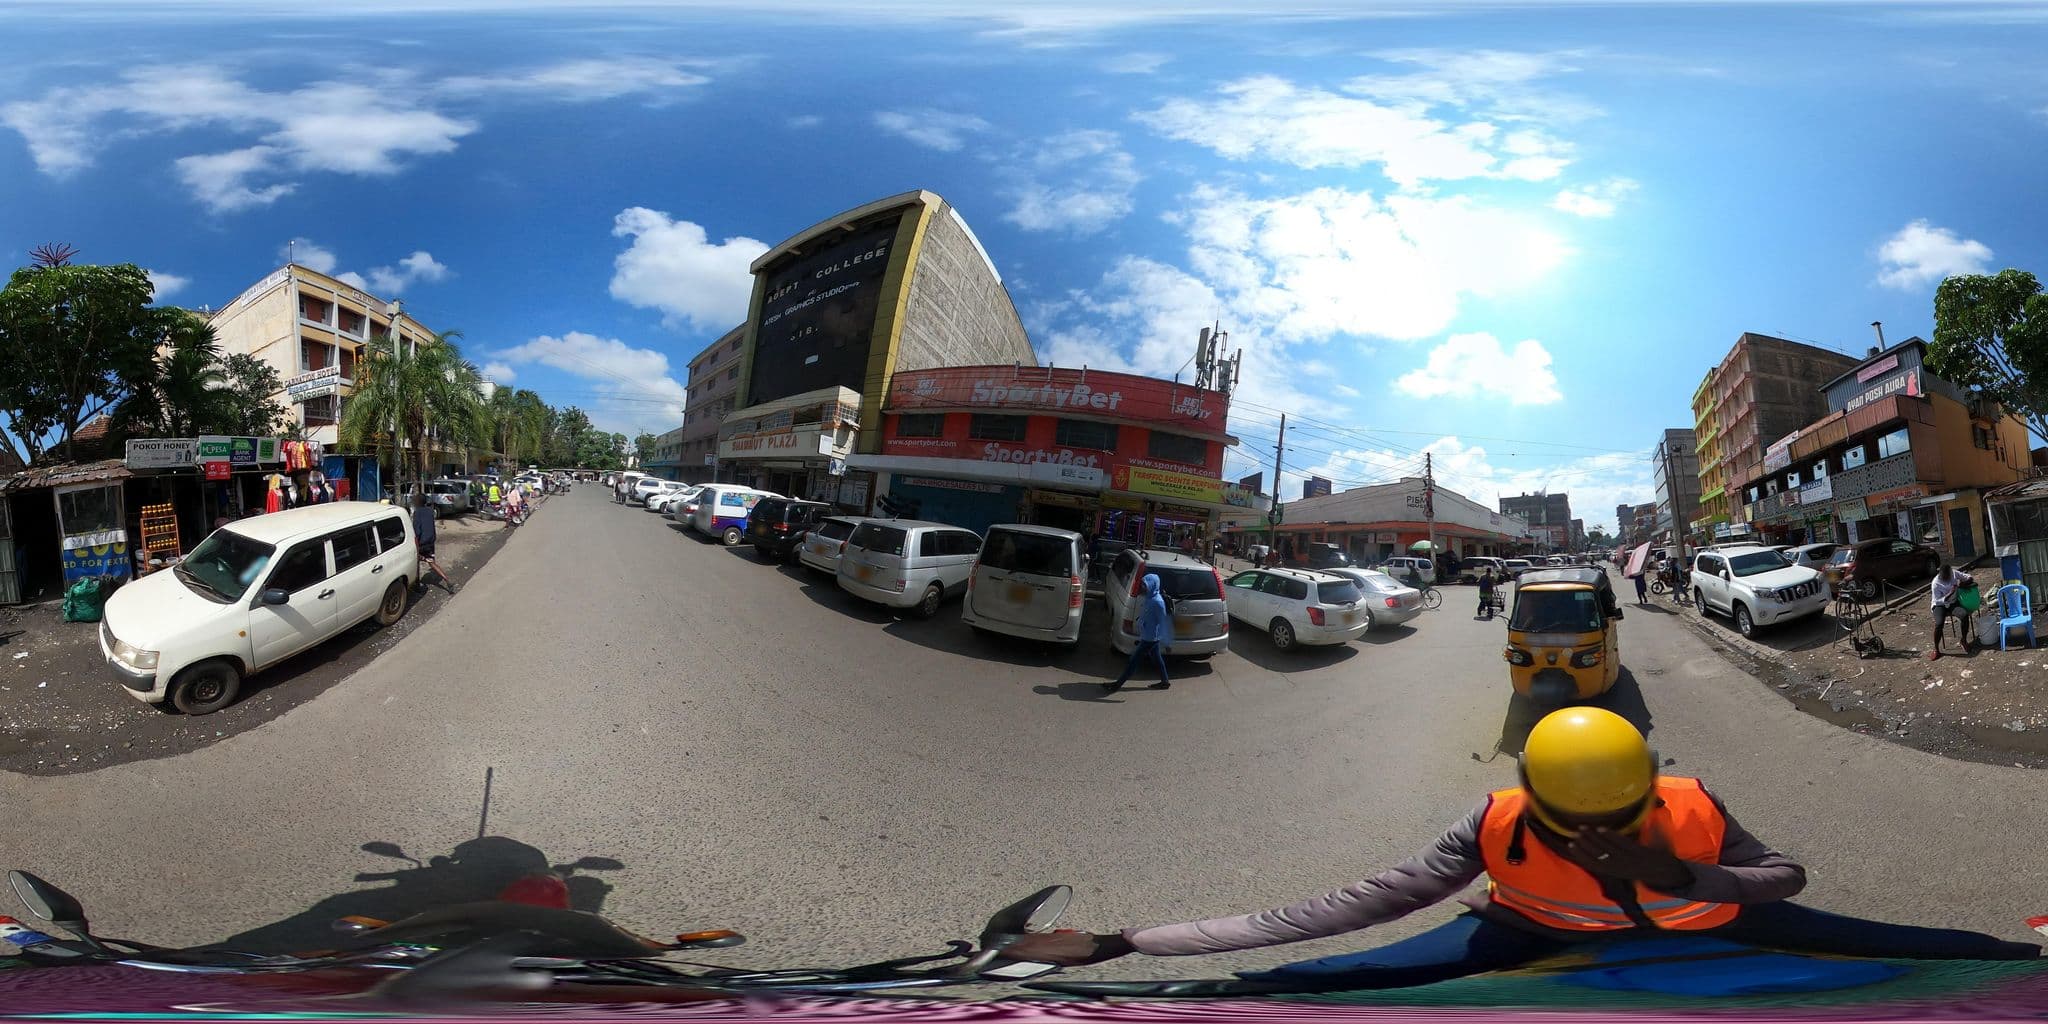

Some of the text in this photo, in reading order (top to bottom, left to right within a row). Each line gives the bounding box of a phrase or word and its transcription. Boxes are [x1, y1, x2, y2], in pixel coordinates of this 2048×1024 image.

[816, 247, 886, 279] COLLEGE
[315, 367, 338, 380] HOTEL
[292, 387, 331, 401] Welcome
[971, 379, 1123, 411] SportyBet
[1864, 385, 1883, 404] POSH
[1884, 376, 1906, 395] AURA
[1183, 396, 1204, 408] BET
[1174, 406, 1212, 419] SPORTY
[768, 434, 797, 449] PLAZA
[887, 438, 957, 448] www.sportybet.com
[982, 442, 1098, 469] SportyBet
[1128, 457, 1216, 478] www.sportybet.com
[82, 559, 102, 567] FOR
